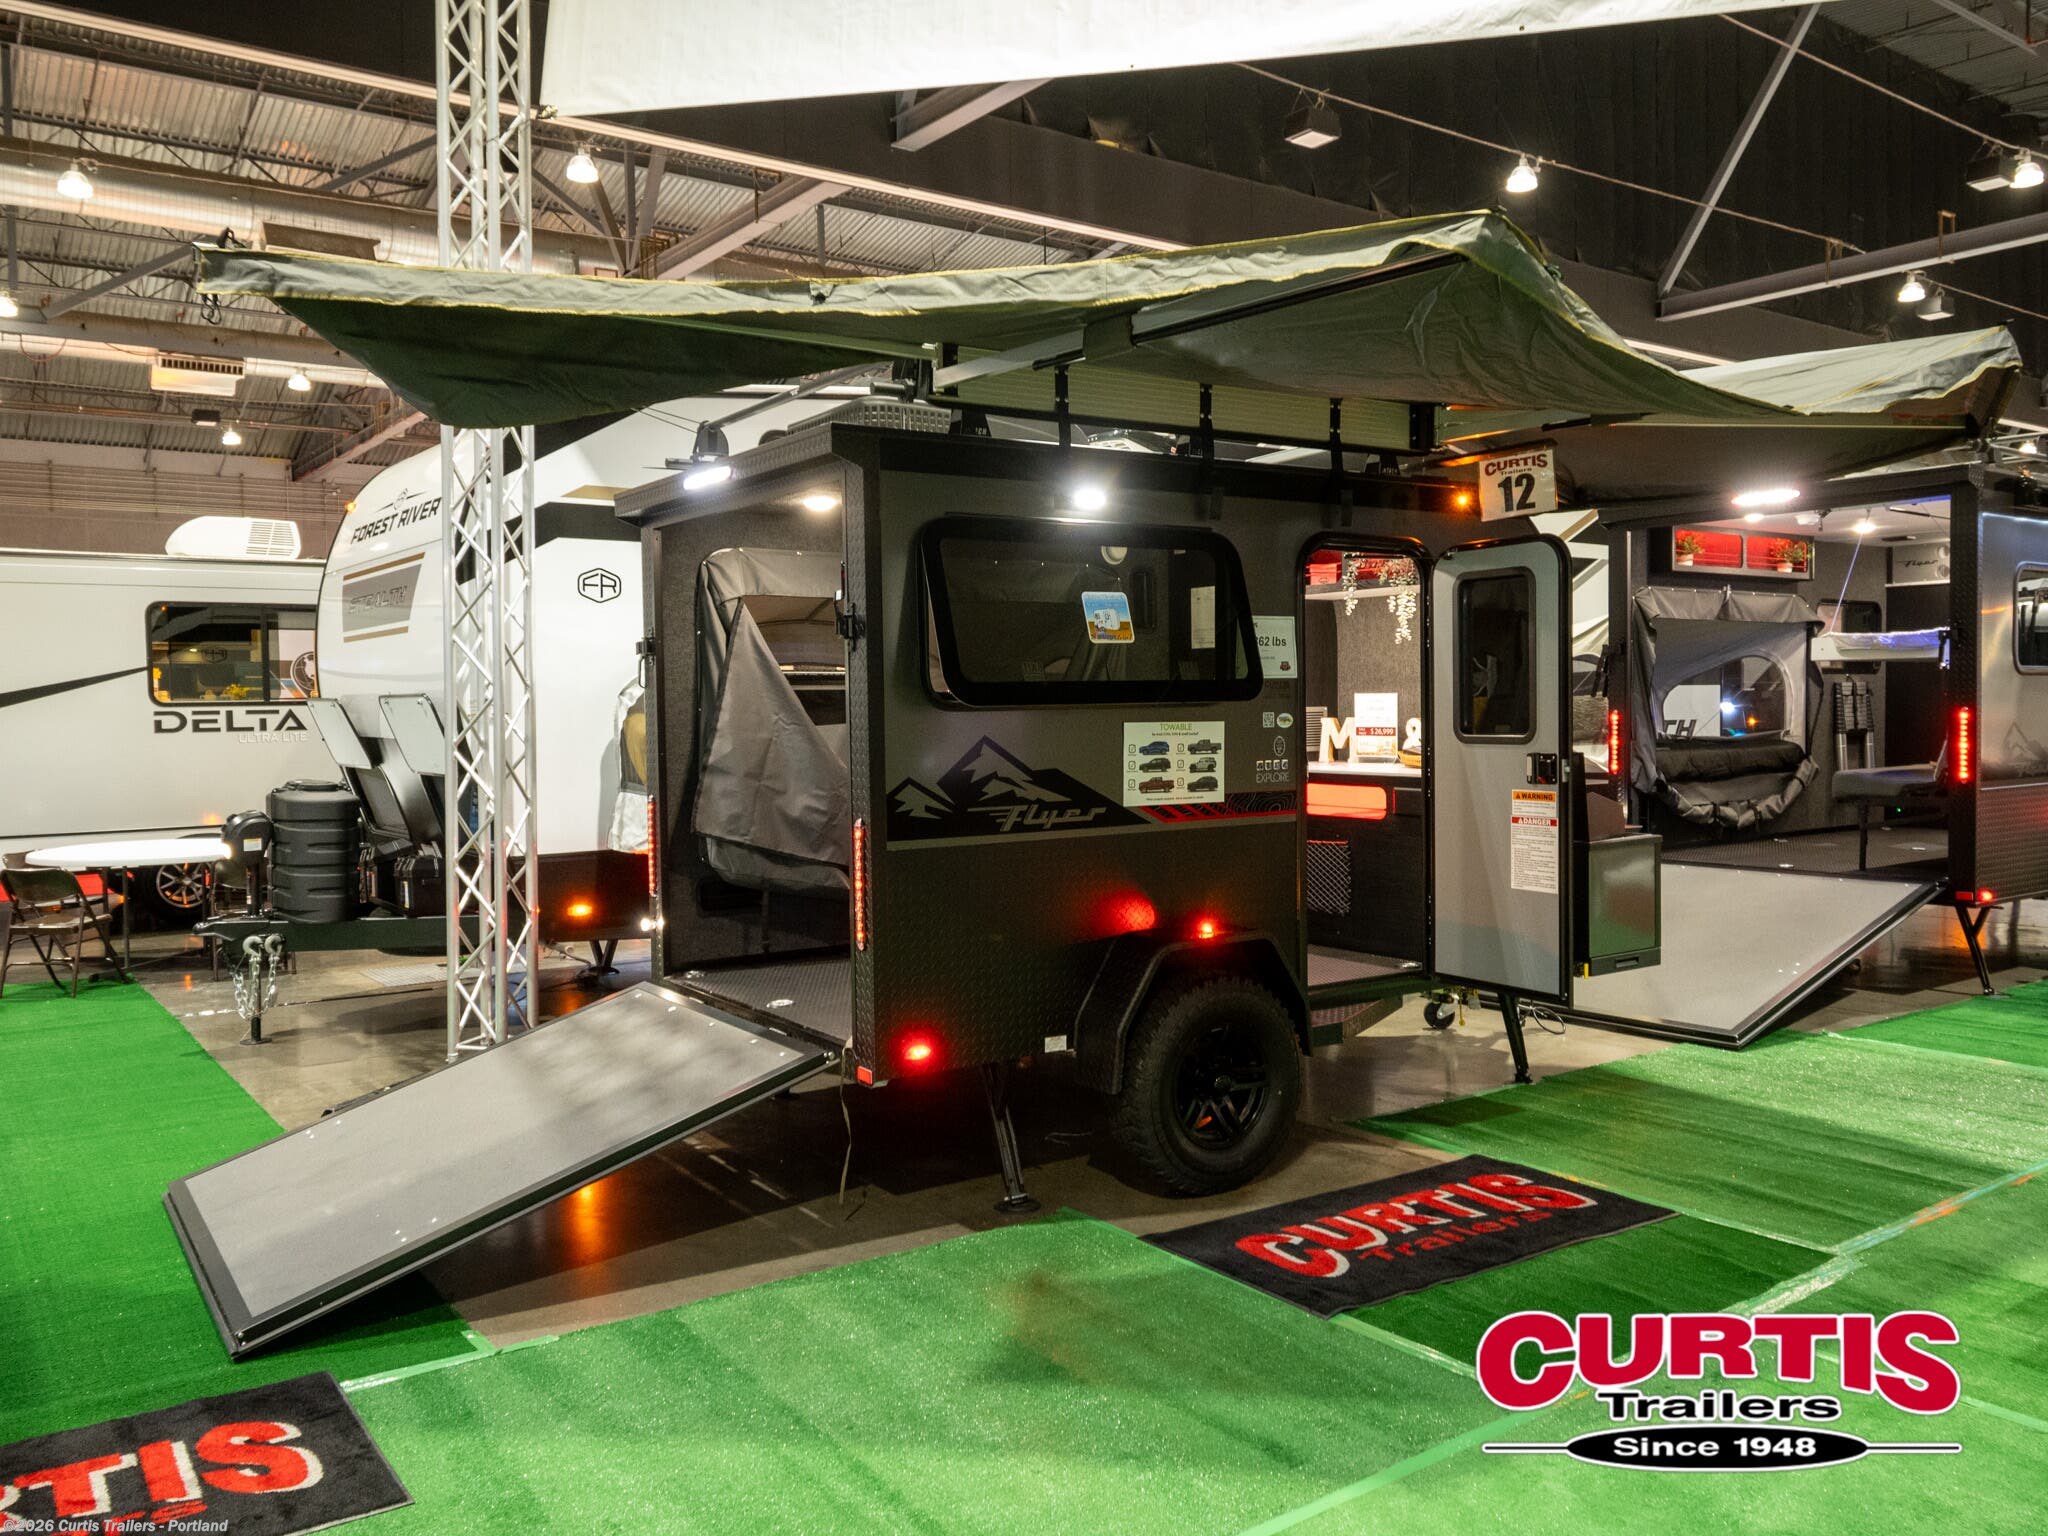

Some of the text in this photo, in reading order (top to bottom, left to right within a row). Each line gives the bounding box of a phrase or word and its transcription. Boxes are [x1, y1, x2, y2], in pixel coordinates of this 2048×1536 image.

[1484, 453, 1548, 476] CURTIS
[1500, 467, 1532, 476] Trailers
[1498, 473, 1536, 512] 12
[350, 513, 398, 545] FOREST
[399, 497, 442, 529] RIVER
[1272, 636, 1287, 647] lbs
[153, 708, 308, 734] DELTA
[1160, 723, 1193, 731] TOWABLE
[239, 732, 309, 743] ULTRA LITE
[1256, 771, 1289, 784] EXPLORE
[1521, 792, 1553, 801] WARNING
[967, 803, 1107, 832] Flyer
[1523, 817, 1551, 826] DANGER
[1235, 1174, 1599, 1278] CURTIS
[1358, 1211, 1551, 1261] Trailers
